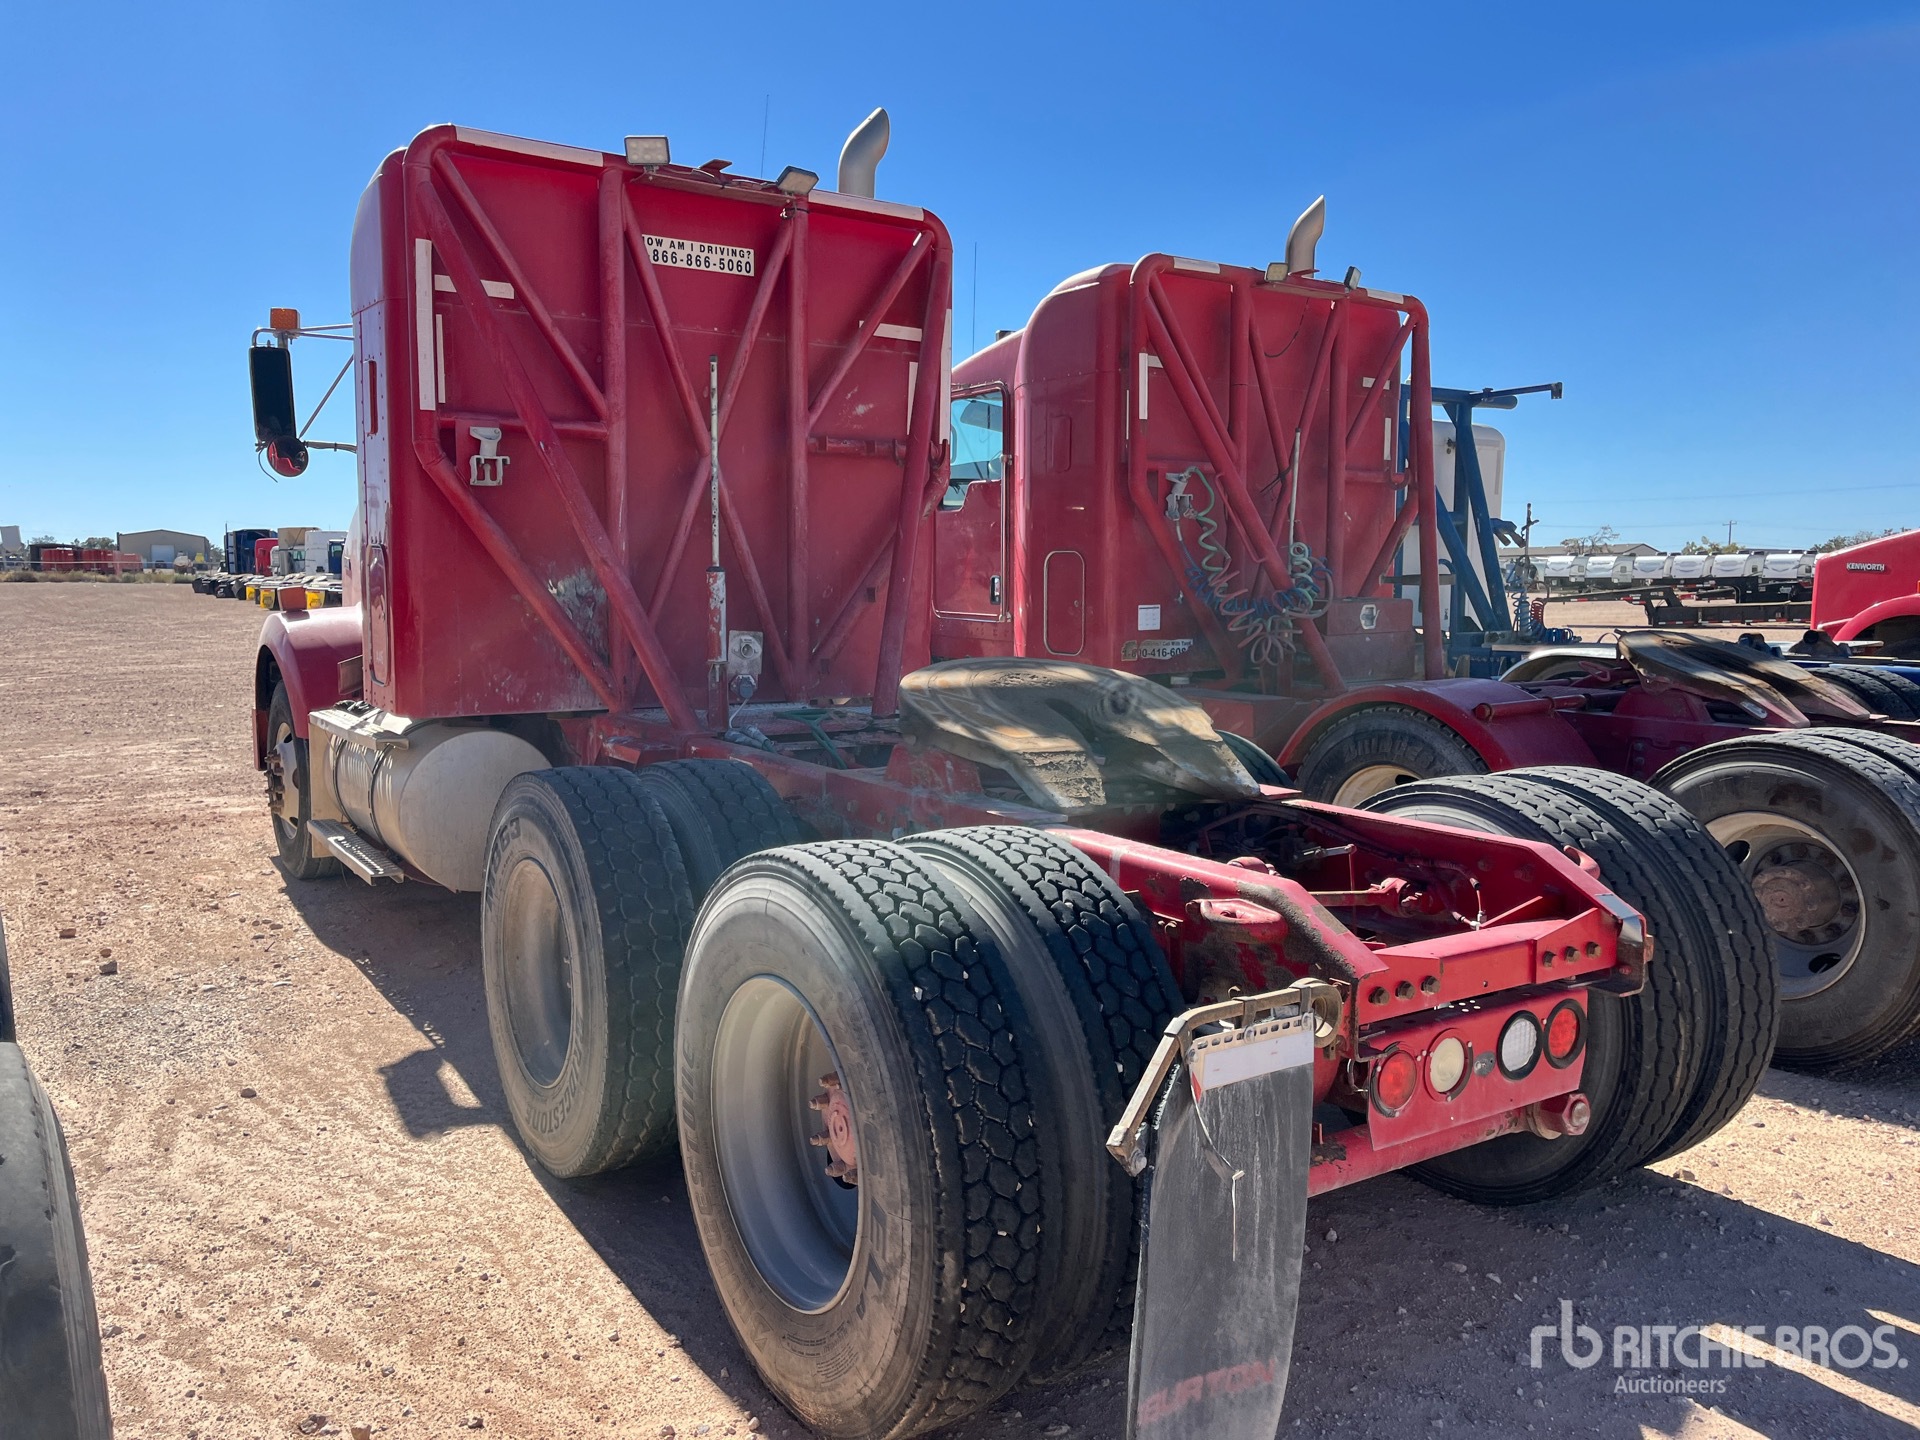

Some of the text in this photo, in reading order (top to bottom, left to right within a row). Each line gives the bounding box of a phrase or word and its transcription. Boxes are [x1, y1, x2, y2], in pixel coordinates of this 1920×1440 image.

[669, 240, 685, 250] AM
[690, 243, 694, 252] I
[700, 244, 751, 259] DRIVING?
[648, 249, 752, 274] 866-866-5060
[1846, 562, 1885, 572] KENWORTH
[1137, 1358, 1276, 1426] BURTON
